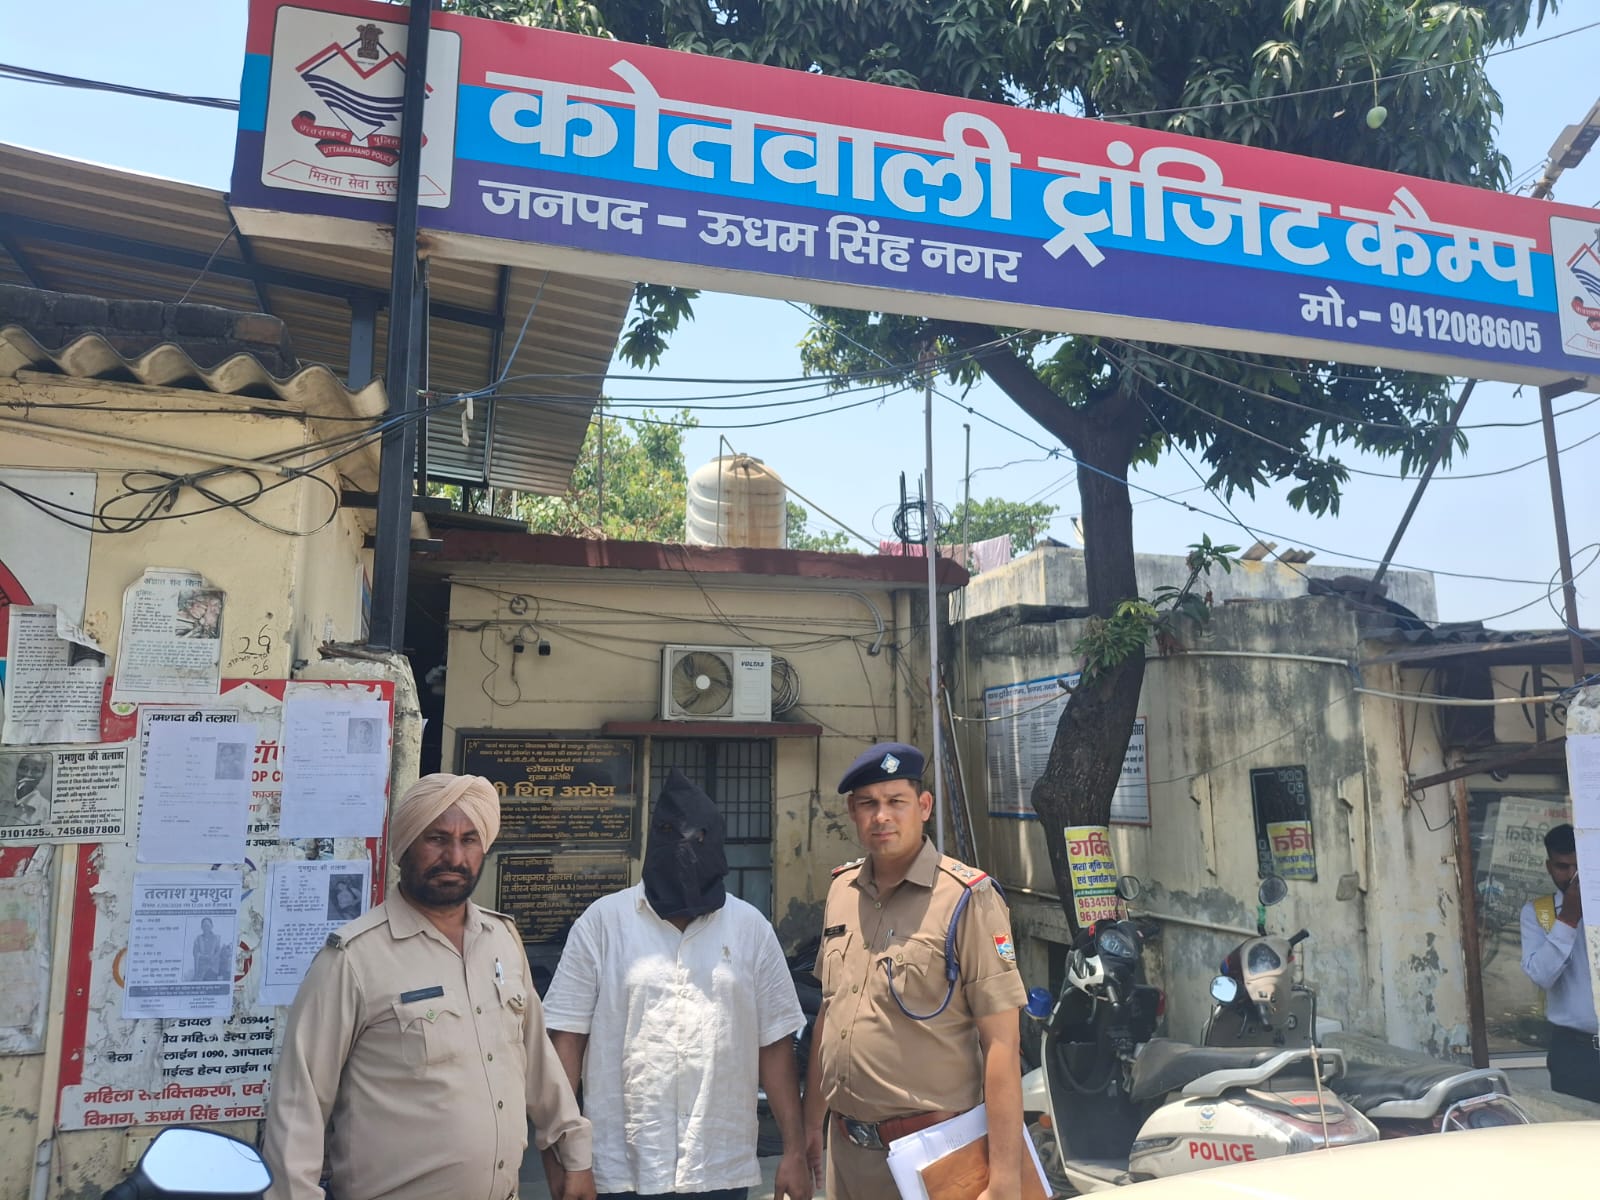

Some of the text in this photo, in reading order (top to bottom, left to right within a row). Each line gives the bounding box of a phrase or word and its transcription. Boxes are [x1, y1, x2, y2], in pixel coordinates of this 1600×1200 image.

[322, 145, 395, 165] UTTARAKHAND POLICE
[308, 165, 342, 186] मित्रता
[348, 175, 370, 190] सेवा
[484, 58, 1538, 298] कोतवाली ट्रांजिट कैम्प
[478, 179, 649, 235] जनपद
[697, 209, 819, 257] ऊधम
[825, 214, 915, 273] सिंह
[920, 239, 1023, 283] नगर
[1389, 301, 1542, 354] 9412088605
[740, 660, 765, 668] VOLTAS
[188, 711, 203, 723] की
[205, 713, 237, 724] तलाश
[57, 753, 86, 765] गुमशुदा
[88, 751, 99, 762] की
[526, 763, 575, 774] लोकार्पण
[514, 781, 554, 798] शिव
[559, 782, 617, 797] अरोरा
[57, 826, 121, 836] 7456887800
[143, 888, 234, 903] तलाश गुमशुदा
[177, 1017, 213, 1028] डायल
[223, 1032, 246, 1042] हेल्प
[249, 1029, 275, 1041] लाई
[163, 1048, 198, 1061] लाईन
[201, 1049, 228, 1060] 1090,
[198, 1064, 222, 1076] हेल्प
[225, 1063, 259, 1075] लाईन
[83, 1086, 134, 1104] महिला
[84, 1110, 141, 1127] विभाग,
[190, 1104, 222, 1121] सिंह
[1188, 1140, 1259, 1162] POLICE
